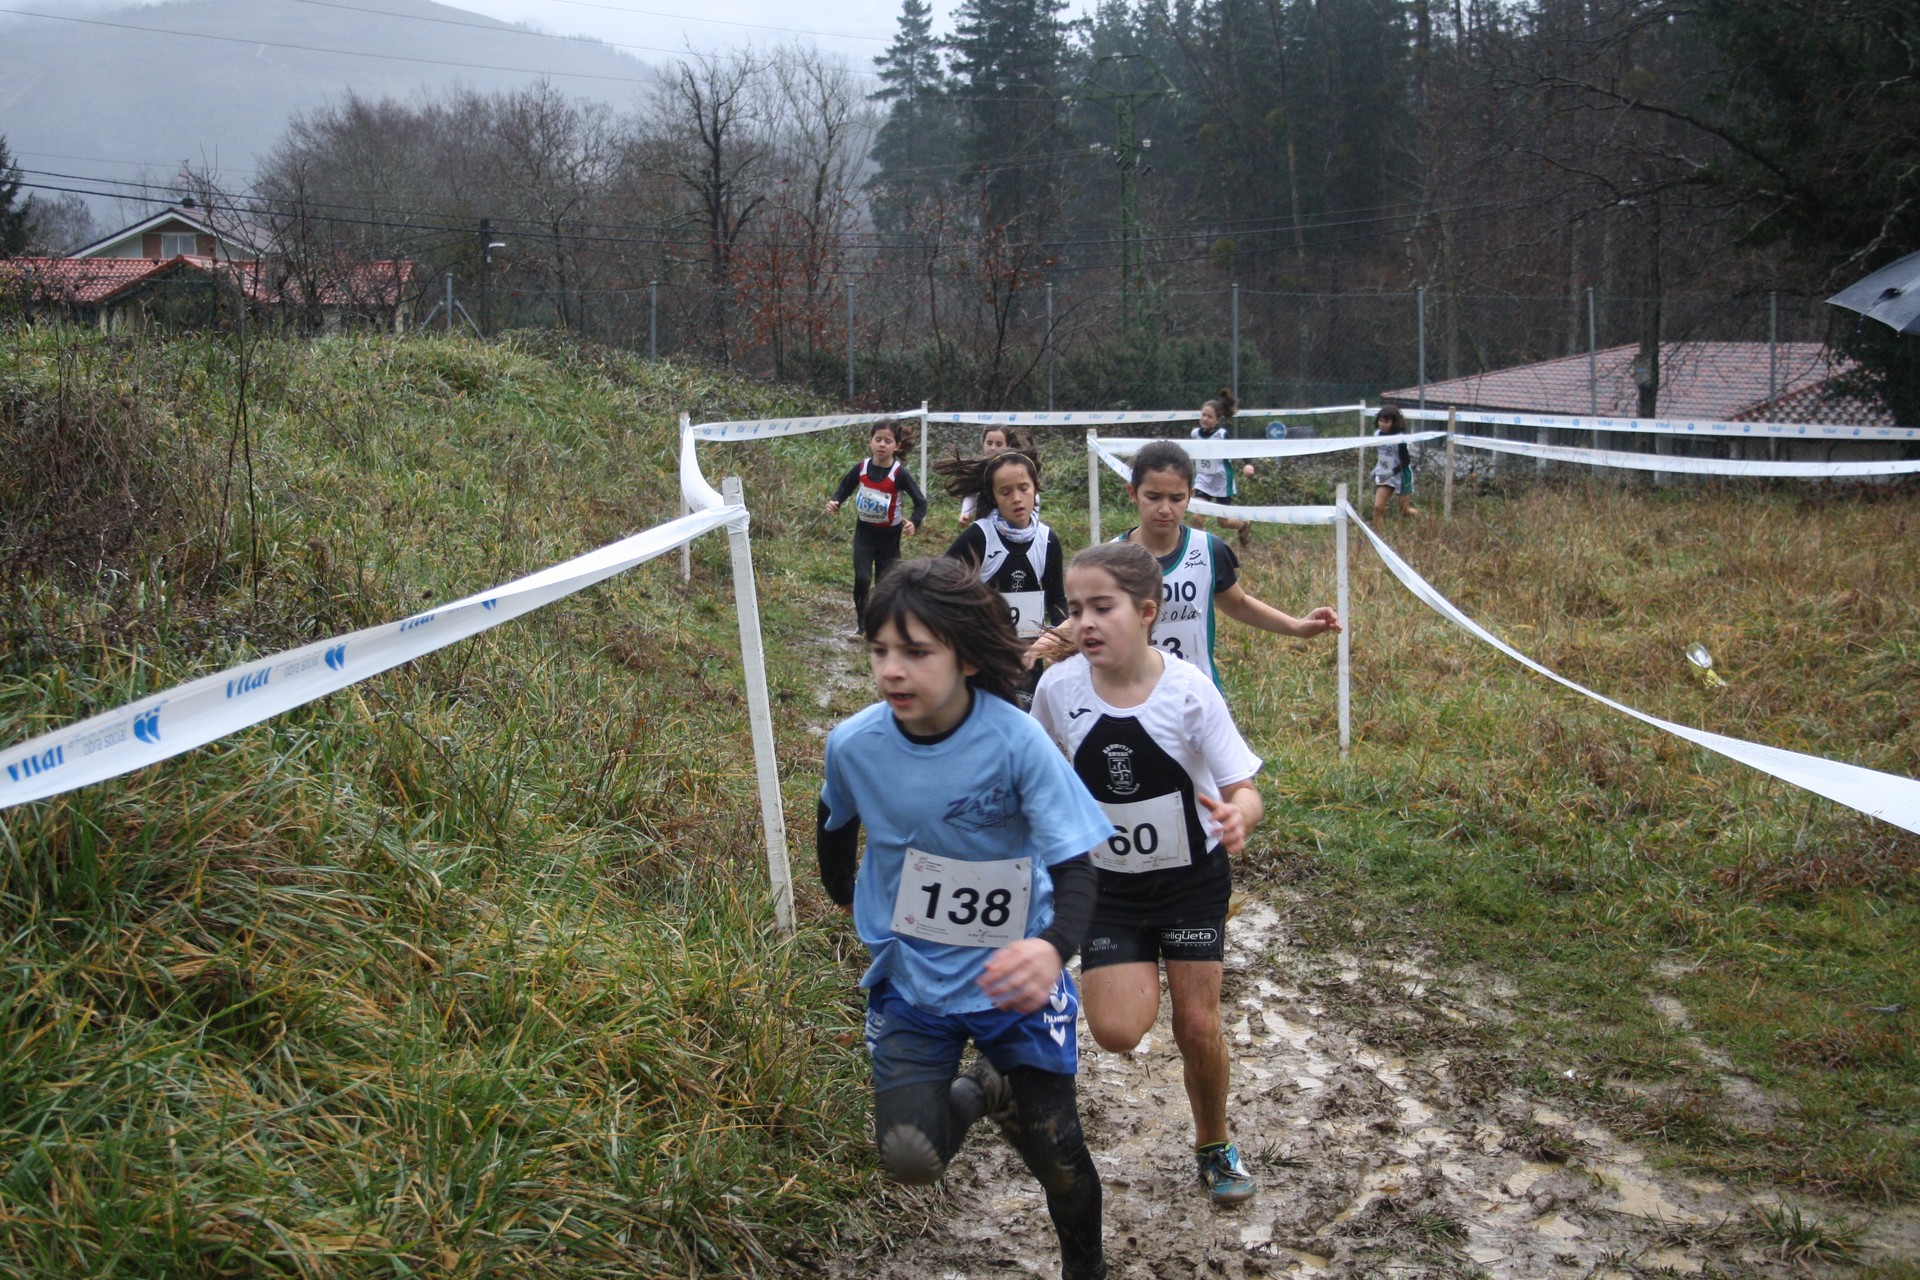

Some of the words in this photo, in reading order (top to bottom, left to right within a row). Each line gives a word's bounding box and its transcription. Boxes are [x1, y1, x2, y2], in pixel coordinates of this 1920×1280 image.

[1200, 459, 1211, 469] 50
[1107, 823, 1158, 856] 60
[921, 882, 1012, 927] 138
